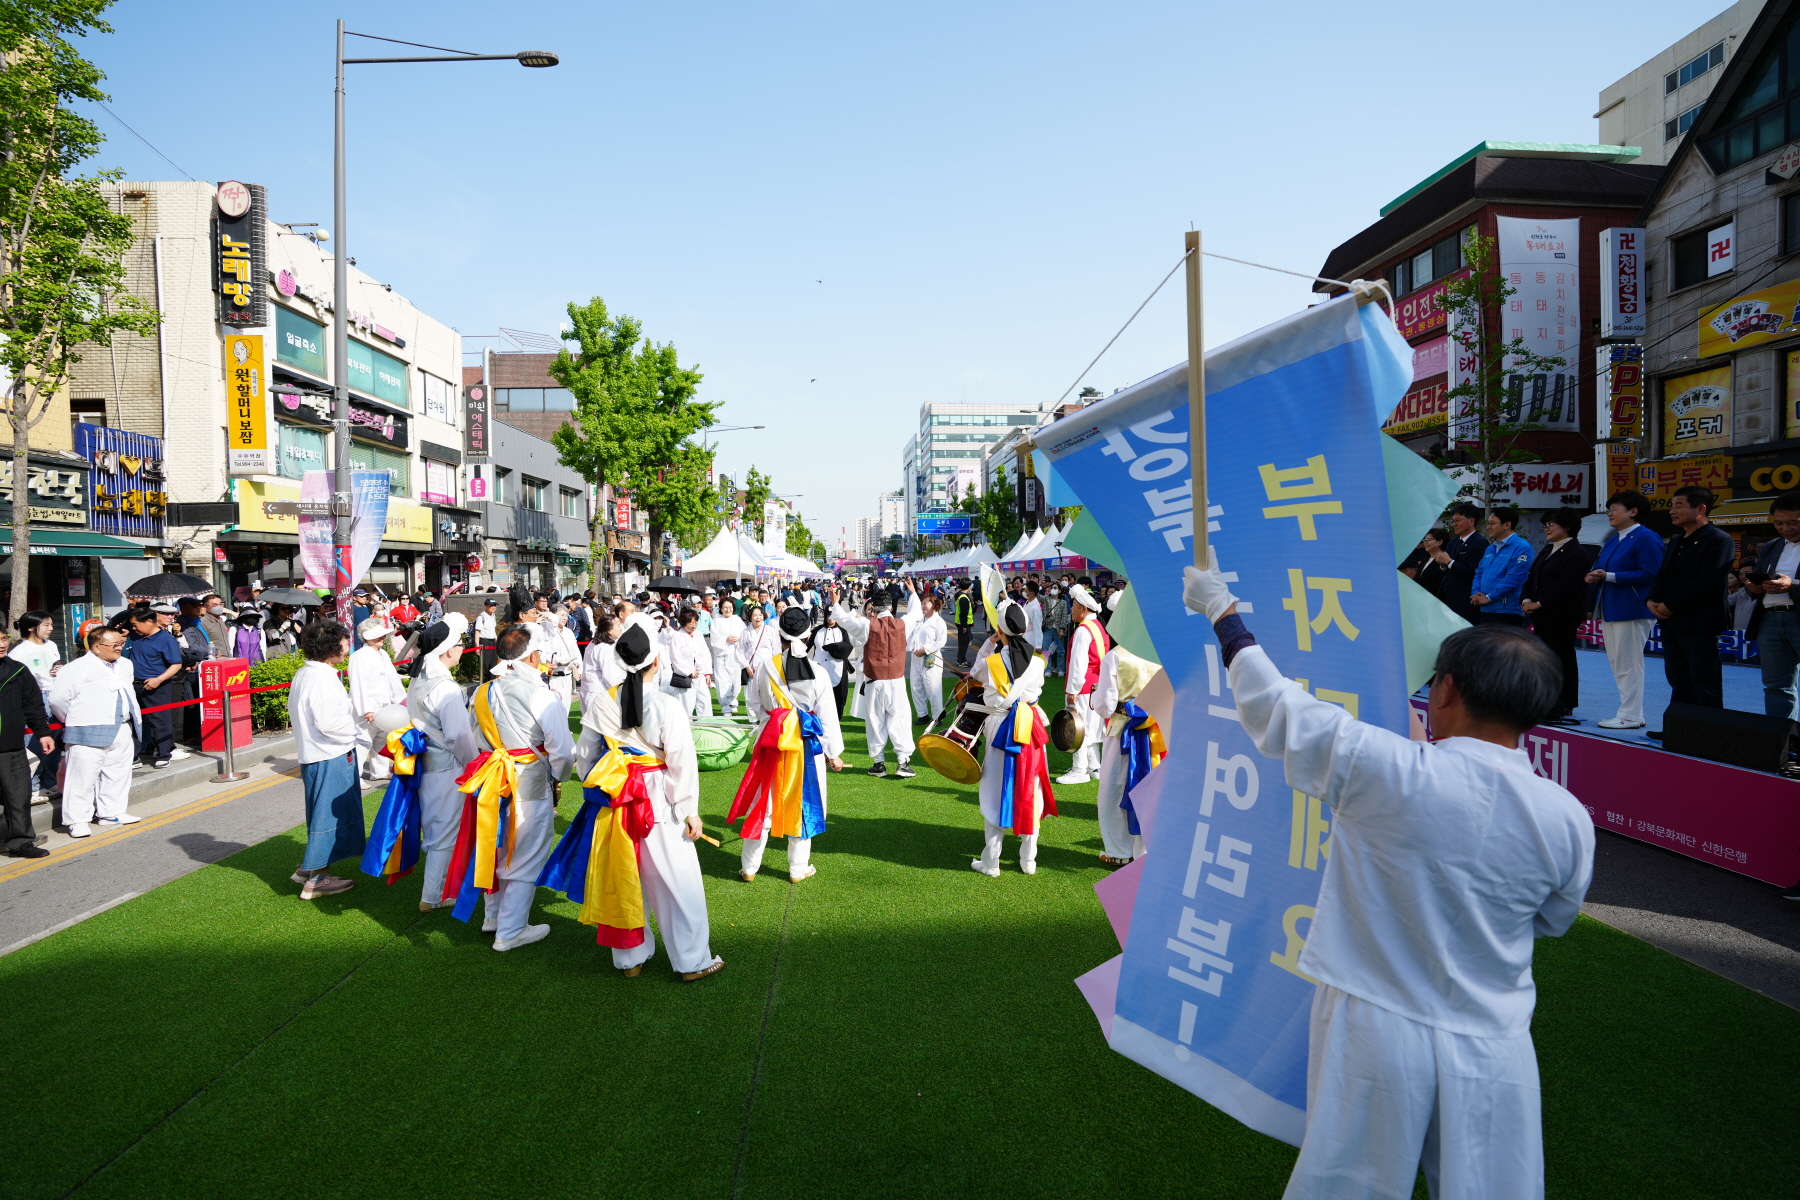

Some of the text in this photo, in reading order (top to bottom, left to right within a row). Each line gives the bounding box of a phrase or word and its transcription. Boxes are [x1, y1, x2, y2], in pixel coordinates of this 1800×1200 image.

[1526, 240, 1565, 252] 동태요리
[222, 234, 252, 306] 노래방
[1535, 271, 1548, 368] 동태지
[1555, 272, 1565, 369] 김치전골찌
[1624, 316, 1633, 324] 3F
[286, 331, 317, 354] 얼굴축소
[1612, 365, 1639, 424] PC
[1619, 427, 1633, 437] 2F
[1674, 414, 1723, 440] 포커
[1609, 444, 1631, 455] 대원
[474, 479, 482, 496] NAIL
[1511, 471, 1583, 495] 동태요리
[1640, 464, 1656, 496] 대원
[1657, 463, 1733, 495] 부동산
[1743, 515, 1769, 523] COFFEE
[68, 559, 83, 567] 1056
[205, 666, 213, 690] 소화기
[1606, 810, 1748, 864] 협찬 강북문화재단 신한은행
